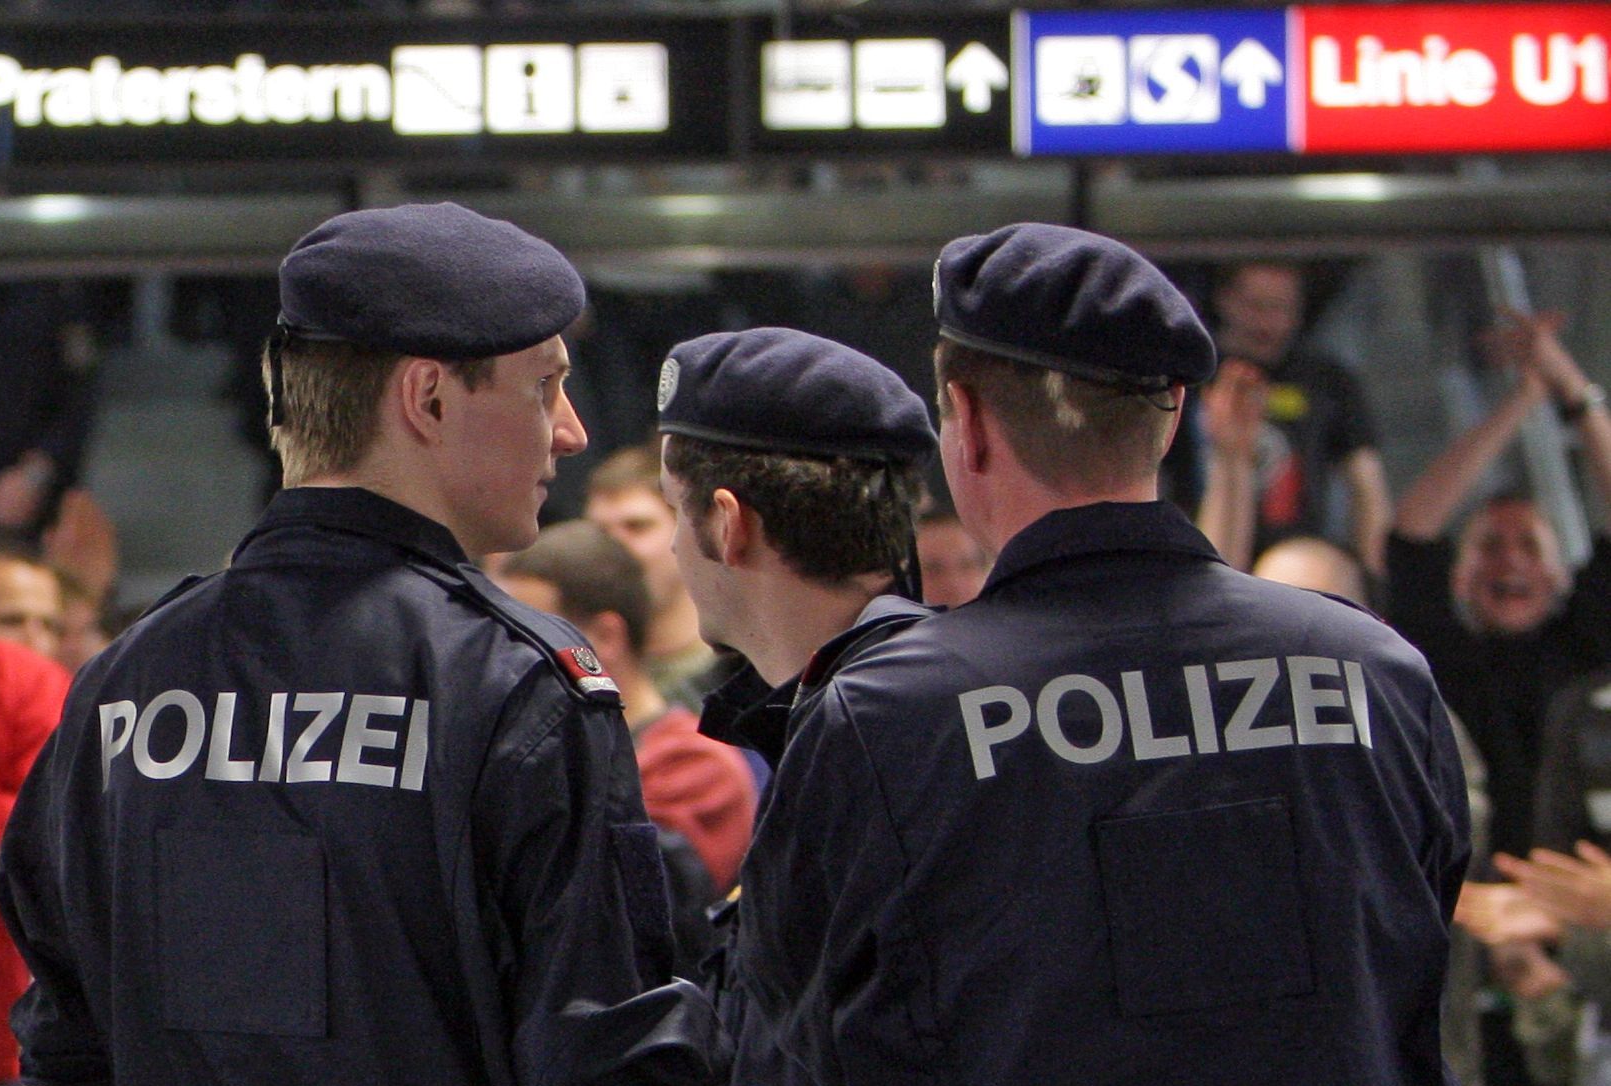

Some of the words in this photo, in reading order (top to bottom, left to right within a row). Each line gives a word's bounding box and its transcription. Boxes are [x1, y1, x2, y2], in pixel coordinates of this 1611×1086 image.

[1311, 35, 1498, 107] Linie
[1511, 33, 1608, 106] U1
[99, 689, 429, 792] POLIZEI
[959, 656, 1373, 780] POLIZEI
